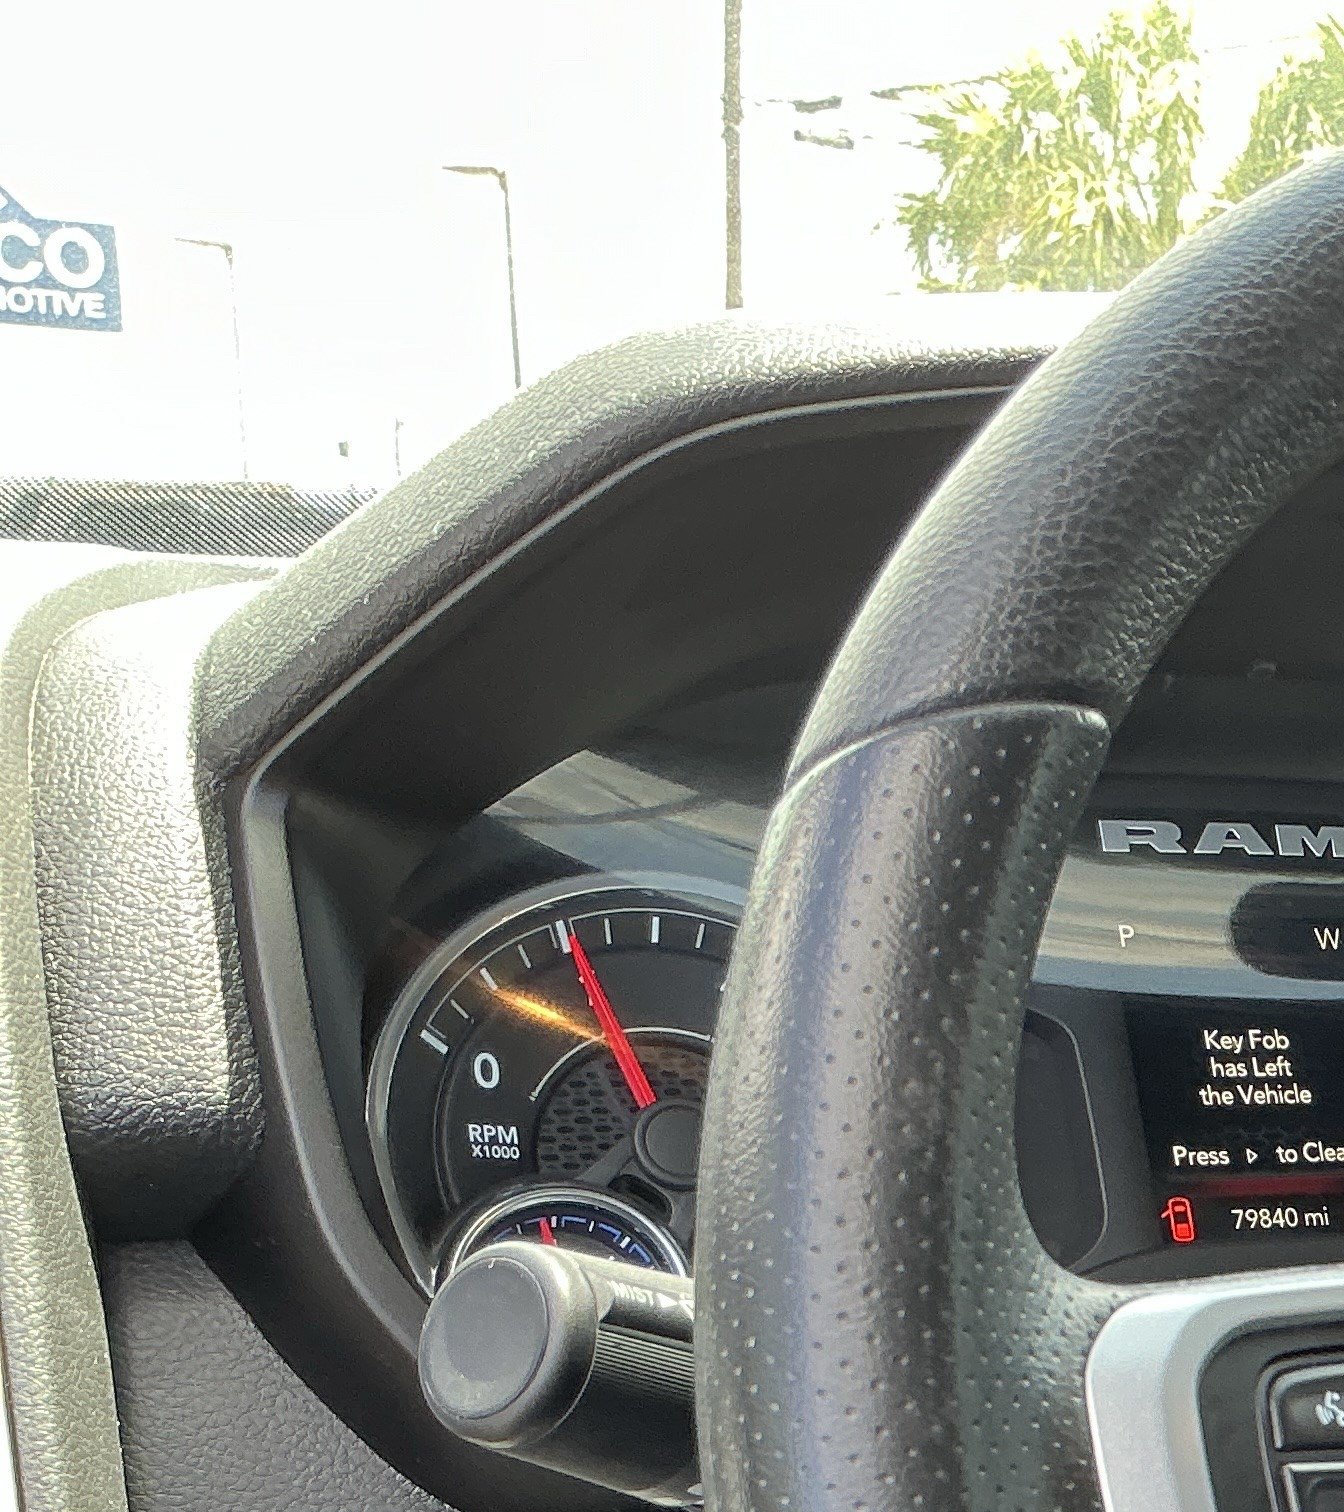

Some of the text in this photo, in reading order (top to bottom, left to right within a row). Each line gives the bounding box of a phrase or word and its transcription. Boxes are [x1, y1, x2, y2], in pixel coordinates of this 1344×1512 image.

[1118, 923, 1340, 951] P W
[1204, 1029, 1289, 1053] Key Fob
[474, 1053, 500, 1088] 0
[1210, 1056, 1293, 1078] has Left
[1199, 1083, 1312, 1106] the Vehicle
[468, 1123, 519, 1145] RPM
[471, 1144, 520, 1160] X1000
[1173, 1145, 1230, 1166] Press
[1276, 1146, 1298, 1163] to
[1231, 1206, 1329, 1229] 79840 mi
